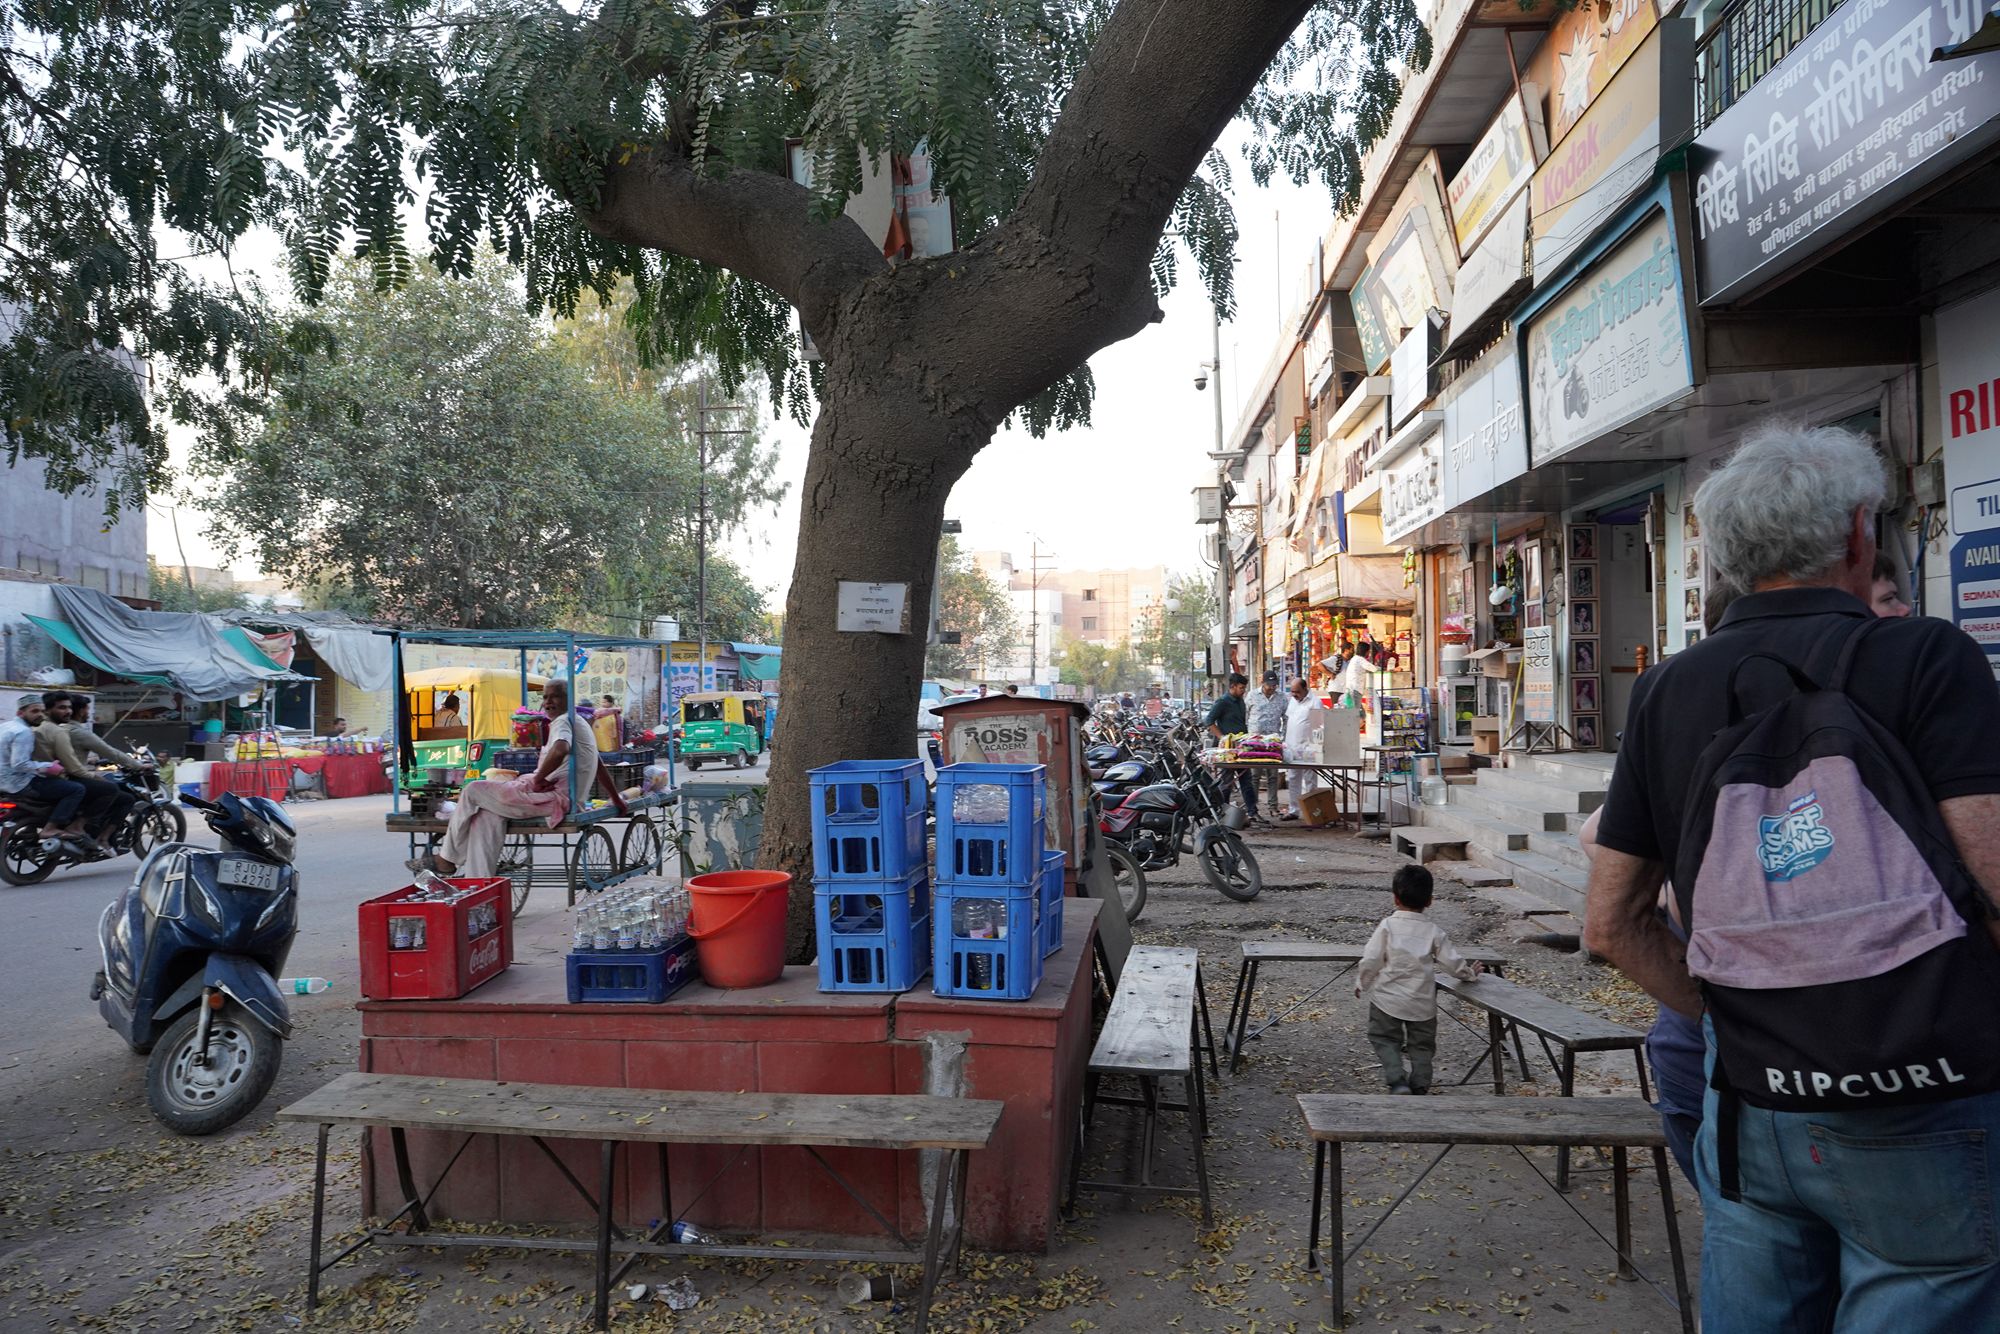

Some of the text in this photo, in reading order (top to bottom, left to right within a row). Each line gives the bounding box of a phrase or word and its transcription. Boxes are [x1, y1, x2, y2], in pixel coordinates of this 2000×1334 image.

[1543, 121, 1600, 212] Kodak
[1742, 111, 1800, 205] सिद्धि
[1814, 194, 1841, 221] भवन
[1843, 179, 1857, 201] के
[1907, 106, 1967, 160] बीकानेर
[1452, 174, 1471, 205] LUX
[1793, 173, 1816, 204] रानी
[1950, 377, 2000, 438] RI
[1526, 652, 1550, 668] स्टेट
[964, 727, 1028, 745] BOSS
[984, 743, 1027, 751] ACADEMY
[1765, 805, 1821, 853] SURF
[235, 861, 273, 876] RJ07J
